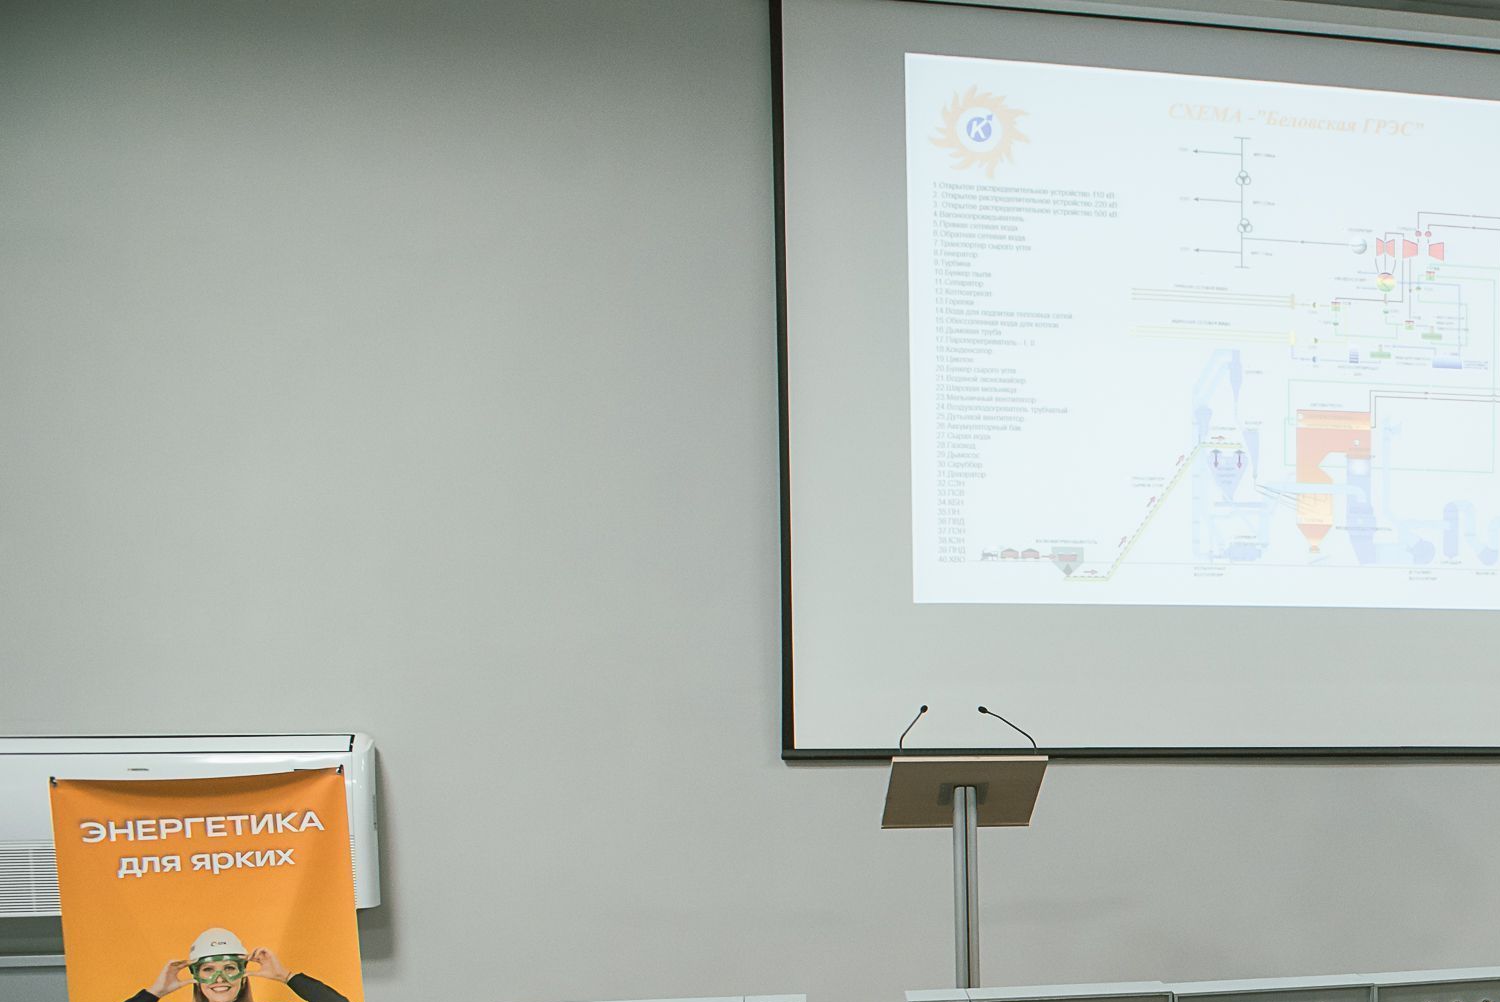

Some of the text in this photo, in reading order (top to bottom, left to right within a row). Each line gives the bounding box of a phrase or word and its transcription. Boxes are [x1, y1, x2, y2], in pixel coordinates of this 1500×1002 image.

[1168, 102, 1242, 123] СХЕМА
[79, 811, 325, 844] ЭНЕРГЕТИКА
[117, 846, 296, 877] для ярких
